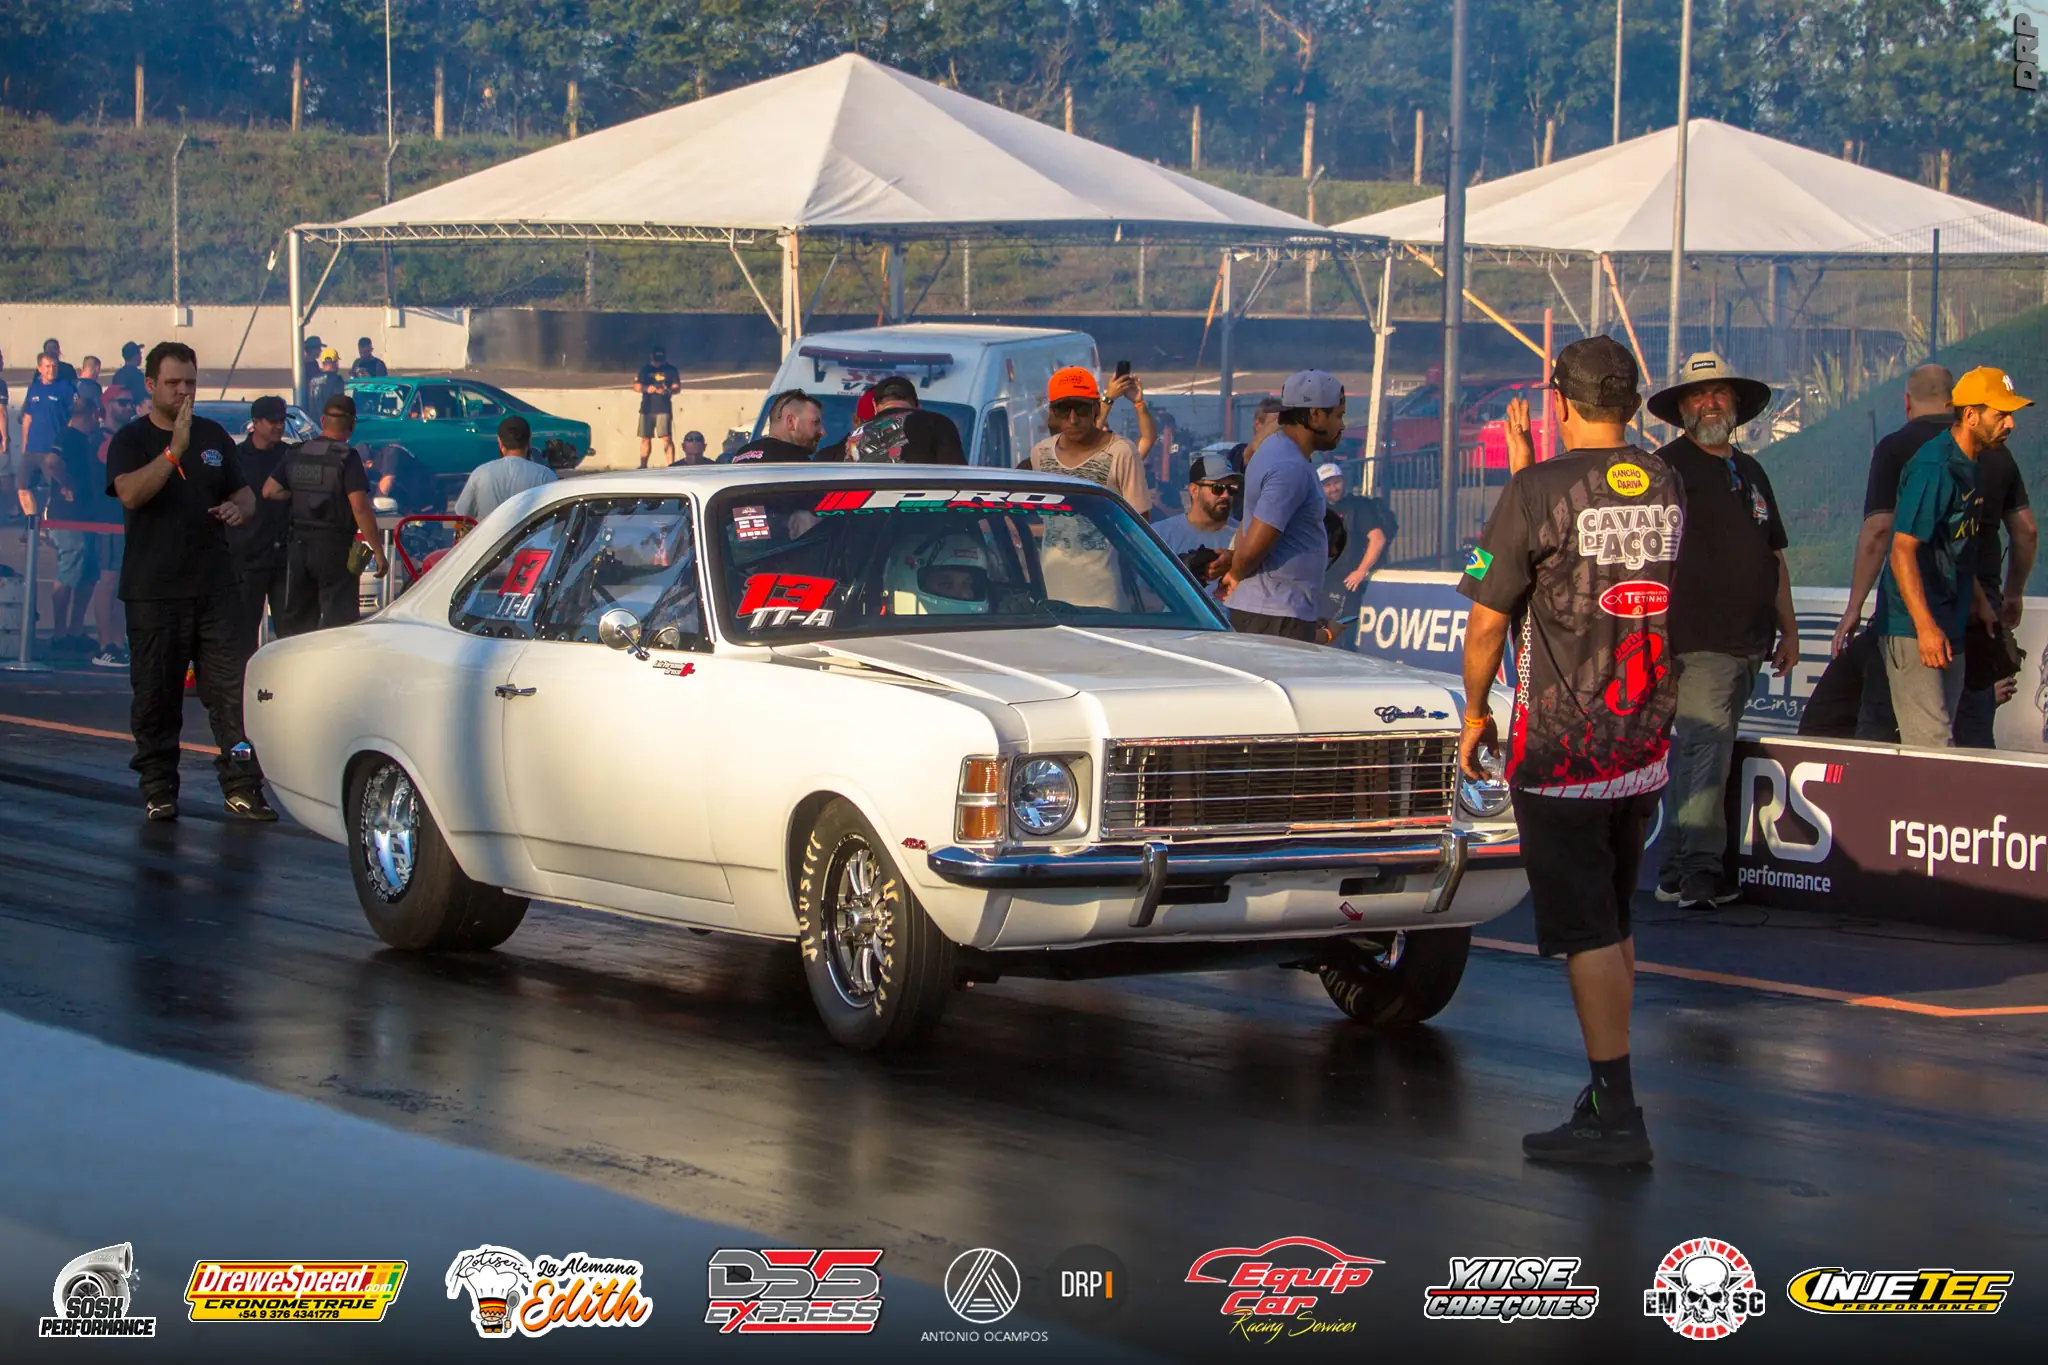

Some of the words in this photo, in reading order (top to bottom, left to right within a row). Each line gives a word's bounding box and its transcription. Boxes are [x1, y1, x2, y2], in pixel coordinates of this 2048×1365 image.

[1612, 468, 1641, 479] RANCHO
[1617, 480, 1643, 490] DARIVA
[861, 490, 1066, 509] PRO
[947, 500, 1073, 511] AUTO
[1578, 506, 1683, 533] CAVALO
[1582, 533, 1604, 550] DE
[1601, 529, 1664, 566] AÇO
[736, 573, 838, 618] 13
[747, 605, 836, 629] TT-A
[1355, 605, 1470, 652] POWER
[1739, 756, 1832, 864] RS
[1738, 865, 1832, 893] performance
